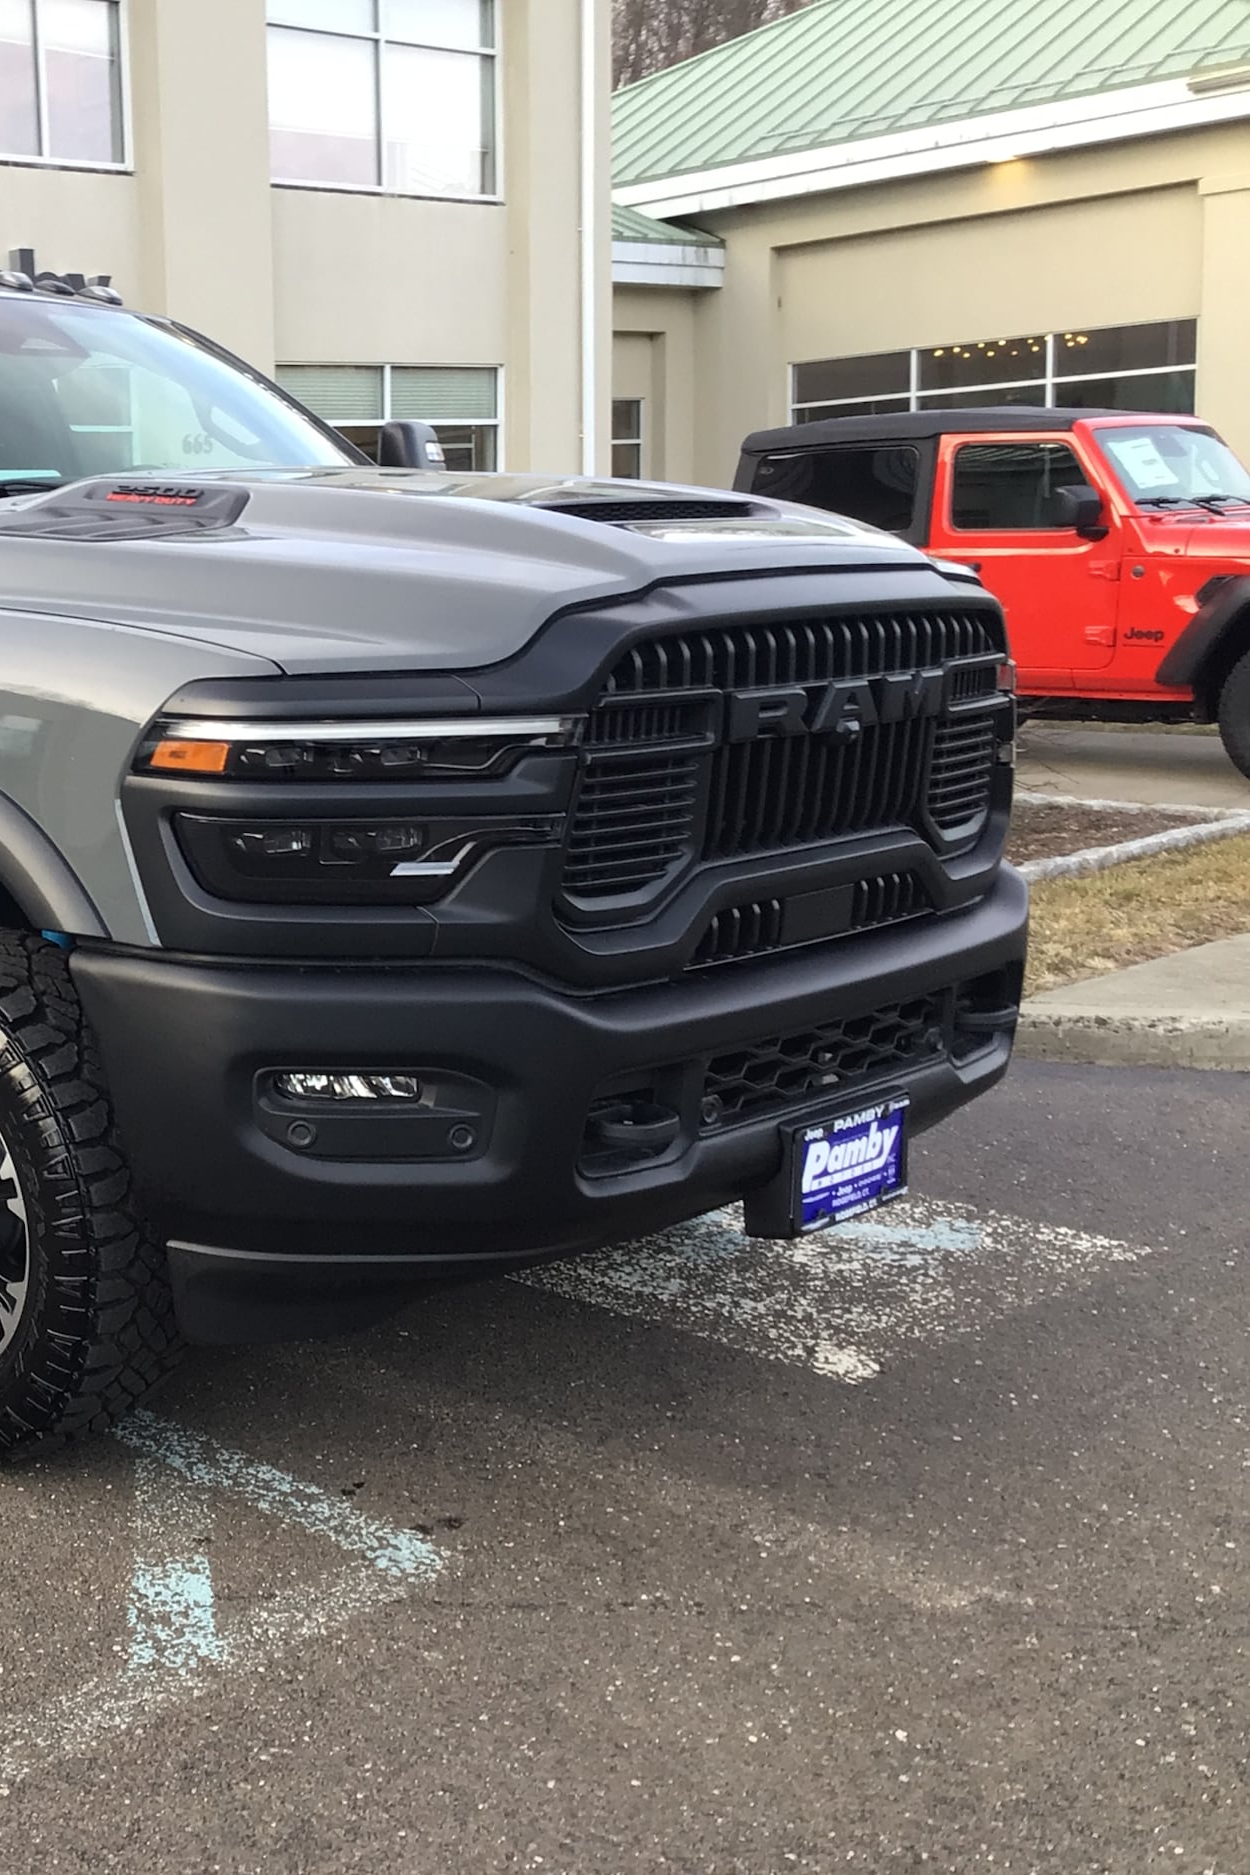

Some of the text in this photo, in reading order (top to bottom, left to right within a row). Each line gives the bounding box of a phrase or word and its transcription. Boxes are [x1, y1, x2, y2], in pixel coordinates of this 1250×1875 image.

[1123, 627, 1164, 642] Jeep
[728, 669, 944, 744] RAM
[833, 1105, 885, 1132] PAMBY
[802, 1122, 899, 1193] Pamby
